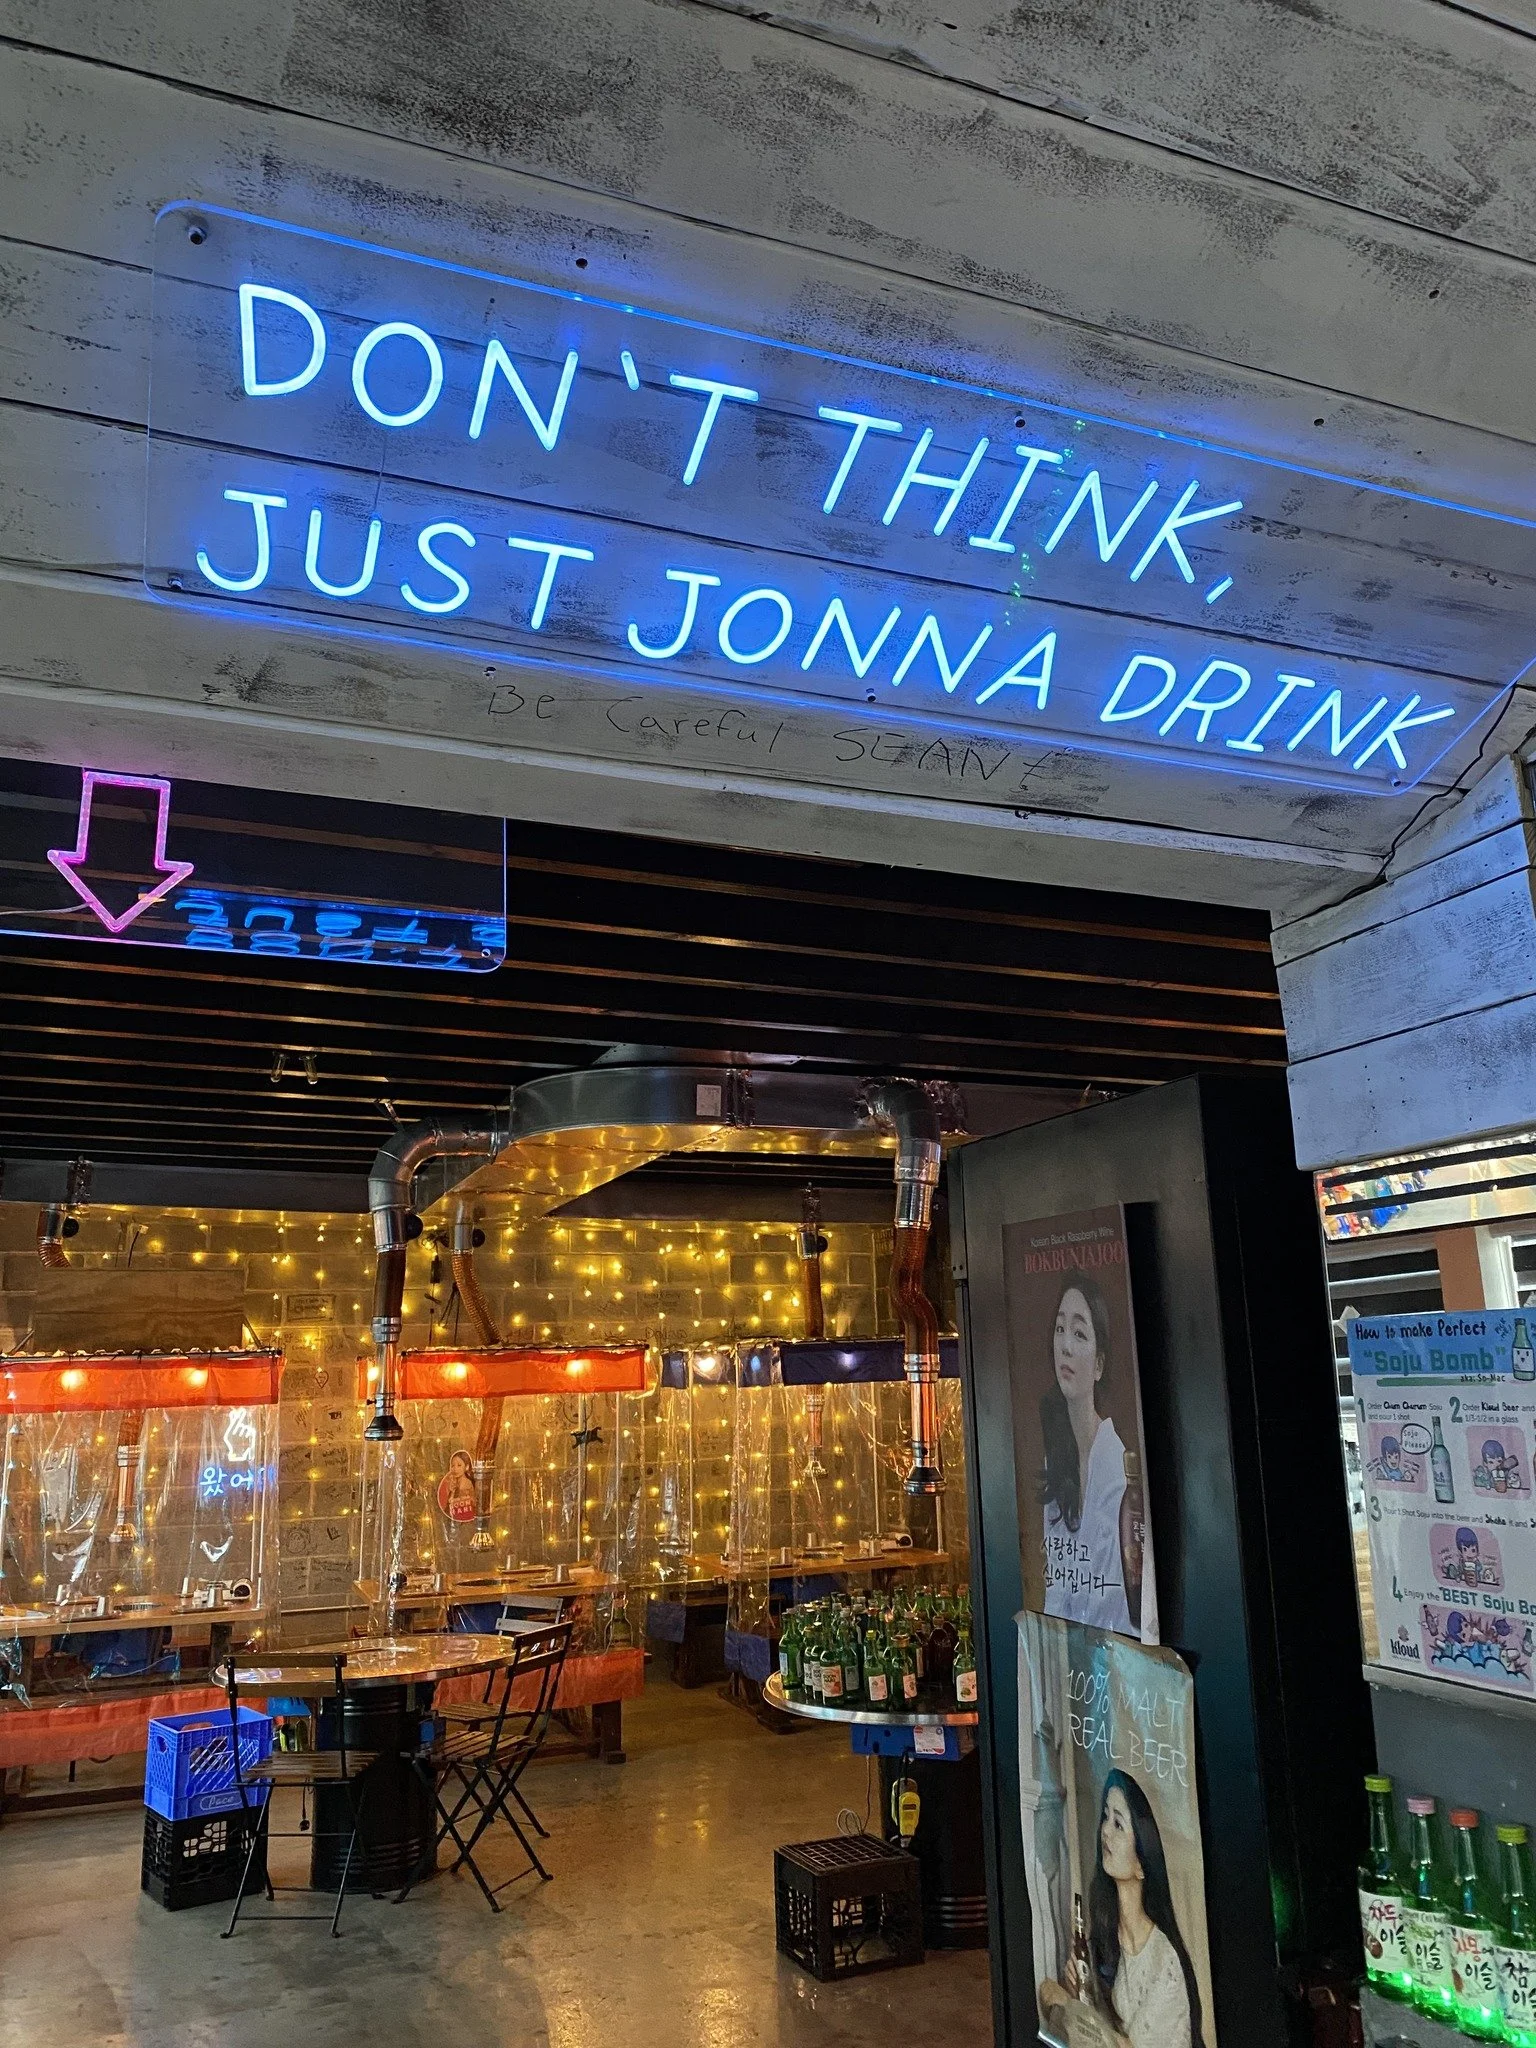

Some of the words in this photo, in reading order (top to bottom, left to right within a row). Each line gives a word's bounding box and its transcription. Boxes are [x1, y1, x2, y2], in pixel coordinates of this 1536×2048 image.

[239, 283, 759, 485] DON'T
[818, 405, 1243, 604] THINK,
[196, 488, 595, 630] JUST
[627, 569, 1057, 710] JONNA
[1100, 655, 1455, 770] DRINK
[487, 684, 555, 720] Be
[606, 695, 782, 754] Careful
[1355, 1323, 1380, 1340] How
[1400, 1322, 1433, 1338] make
[1437, 1318, 1487, 1337] Perfect
[1358, 1397, 1366, 1423] 1
[1449, 1396, 1463, 1424] 2
[1370, 1496, 1382, 1522] 3
[1041, 1536, 1090, 1562] 사랑하고
[1043, 1563, 1121, 1597] 싶어집니다
[1393, 1575, 1403, 1602] 4
[1483, 1594, 1515, 1615] Soju
[1066, 1669, 1111, 1714] 100%
[1118, 1681, 1184, 1732] MALT
[1067, 1713, 1123, 1760] REAL
[1128, 1730, 1189, 1788] BEER
[1416, 1942, 1443, 1970] 이슬
[1465, 1962, 1495, 1991] 이슬
